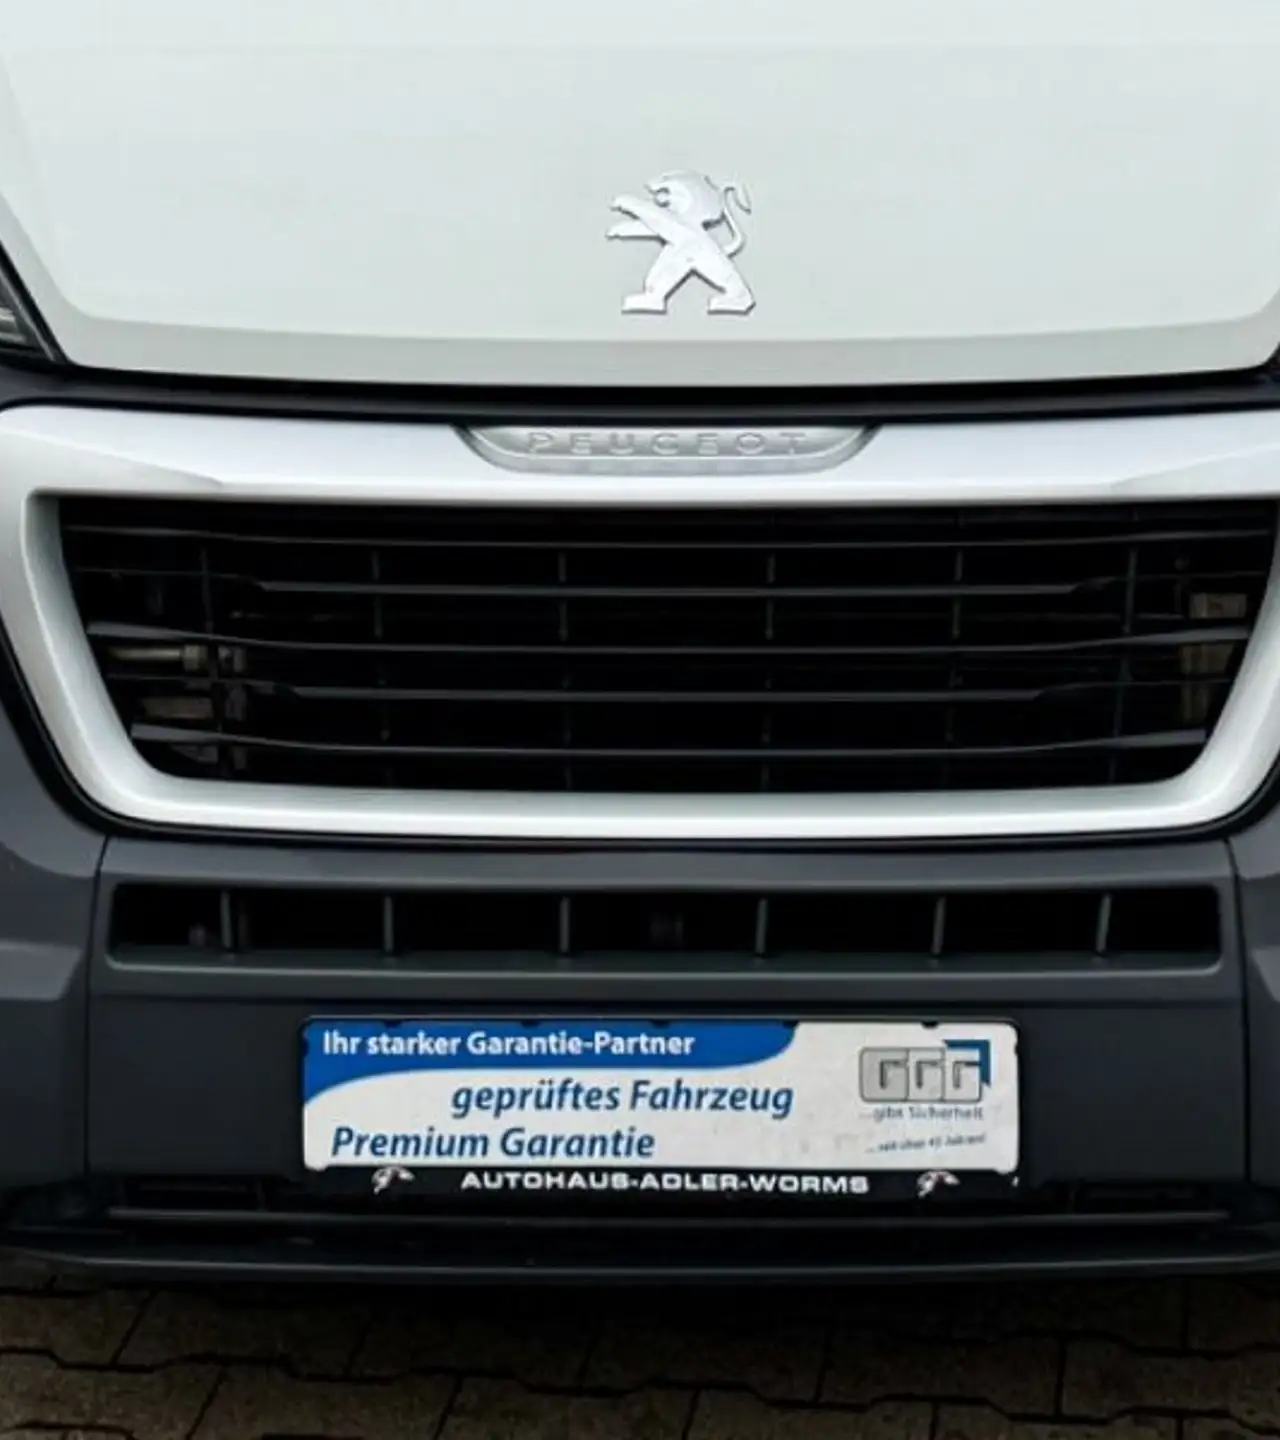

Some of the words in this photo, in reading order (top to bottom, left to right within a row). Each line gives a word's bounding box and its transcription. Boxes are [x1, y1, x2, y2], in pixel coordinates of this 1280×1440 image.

[527, 431, 807, 456] PEUGEOT
[323, 1030, 364, 1056] Ihr
[366, 1030, 461, 1056] starker
[466, 1030, 695, 1056] Garantie-Partner
[450, 1078, 621, 1119] geprüftes
[629, 1080, 795, 1119] Fahrzeug
[331, 1127, 489, 1158] Premium
[500, 1126, 656, 1158] Garantie
[460, 1170, 870, 1196] AUTOHAUS-ADLER-WORMS
